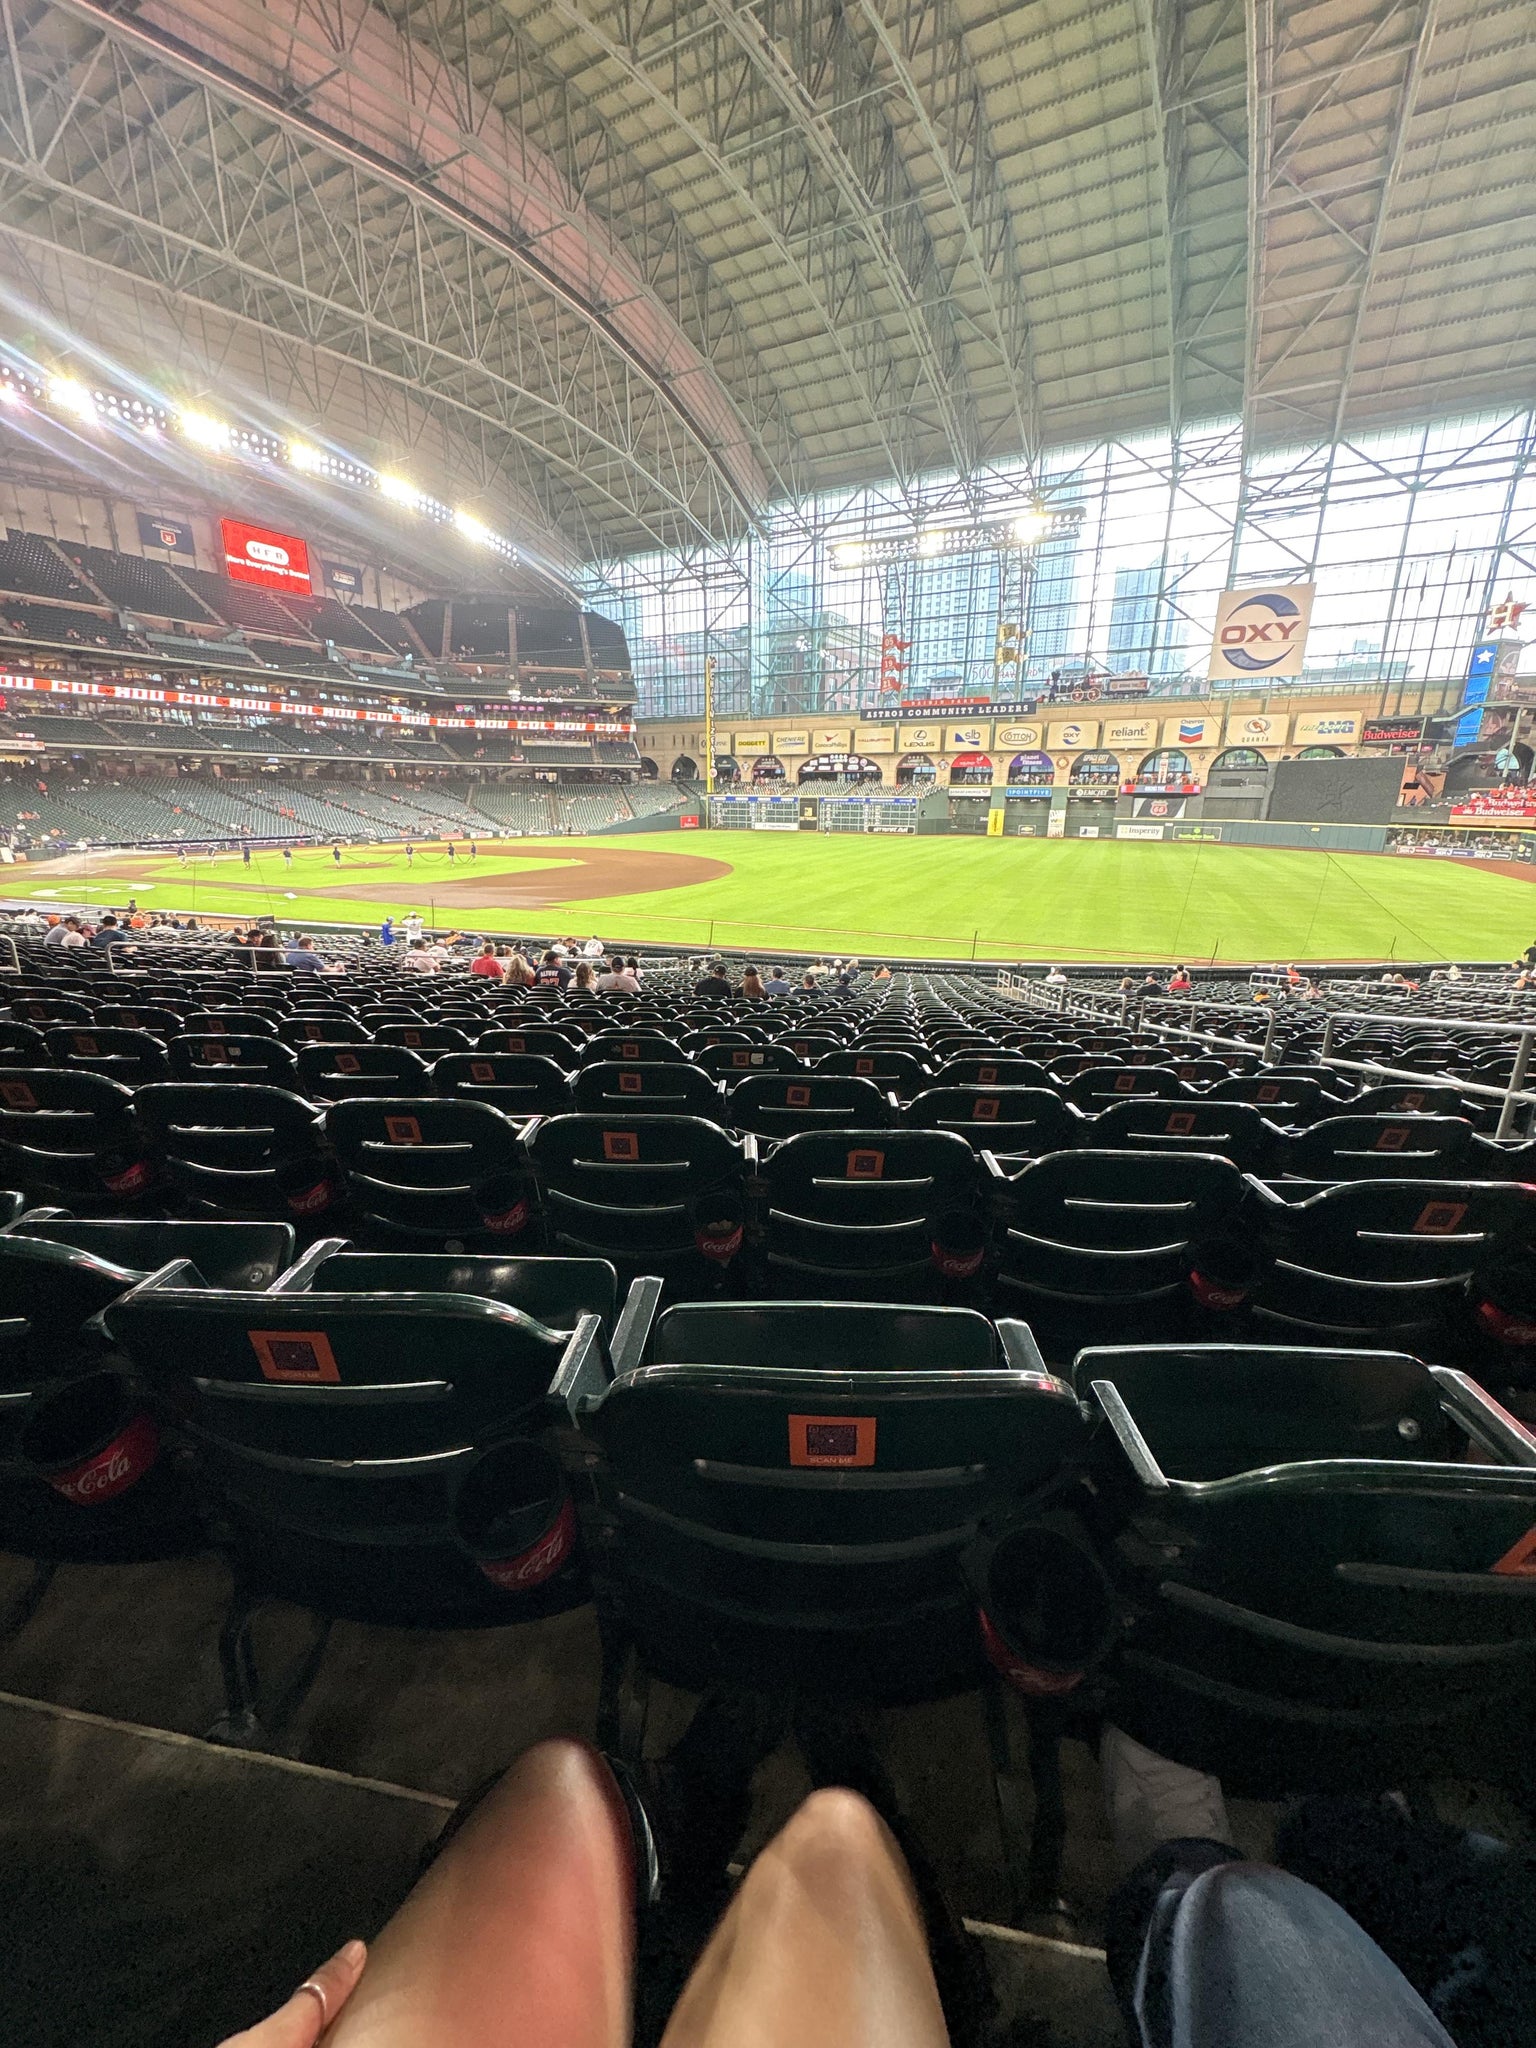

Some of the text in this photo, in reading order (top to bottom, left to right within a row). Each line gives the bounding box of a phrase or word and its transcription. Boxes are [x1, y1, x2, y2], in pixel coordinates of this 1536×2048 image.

[1220, 620, 1302, 644] OXY
[884, 638, 894, 646] 05
[884, 660, 893, 668] 19
[52, 680, 98, 695] COL
[115, 686, 165, 702] HOU
[178, 692, 216, 706] COL
[229, 697, 270, 712] HOU
[281, 702, 312, 715] COL
[323, 706, 357, 720] HOU
[366, 711, 392, 723] COL
[401, 714, 429, 725] HOU
[437, 718, 465, 728] COL
[475, 719, 508, 729] HOU
[518, 720, 545, 731] COL
[554, 721, 585, 732] HOU
[595, 723, 621, 732] COL
[866, 704, 1029, 718] ASTROS COMMUNITY LEADERS
[965, 729, 981, 740] slb
[1111, 727, 1145, 737] reliant
[1363, 729, 1420, 740] Budweiser
[1474, 806, 1527, 816] Budweiser
[1128, 827, 1160, 835] Insperity
[540, 970, 559, 978] ALTUVE
